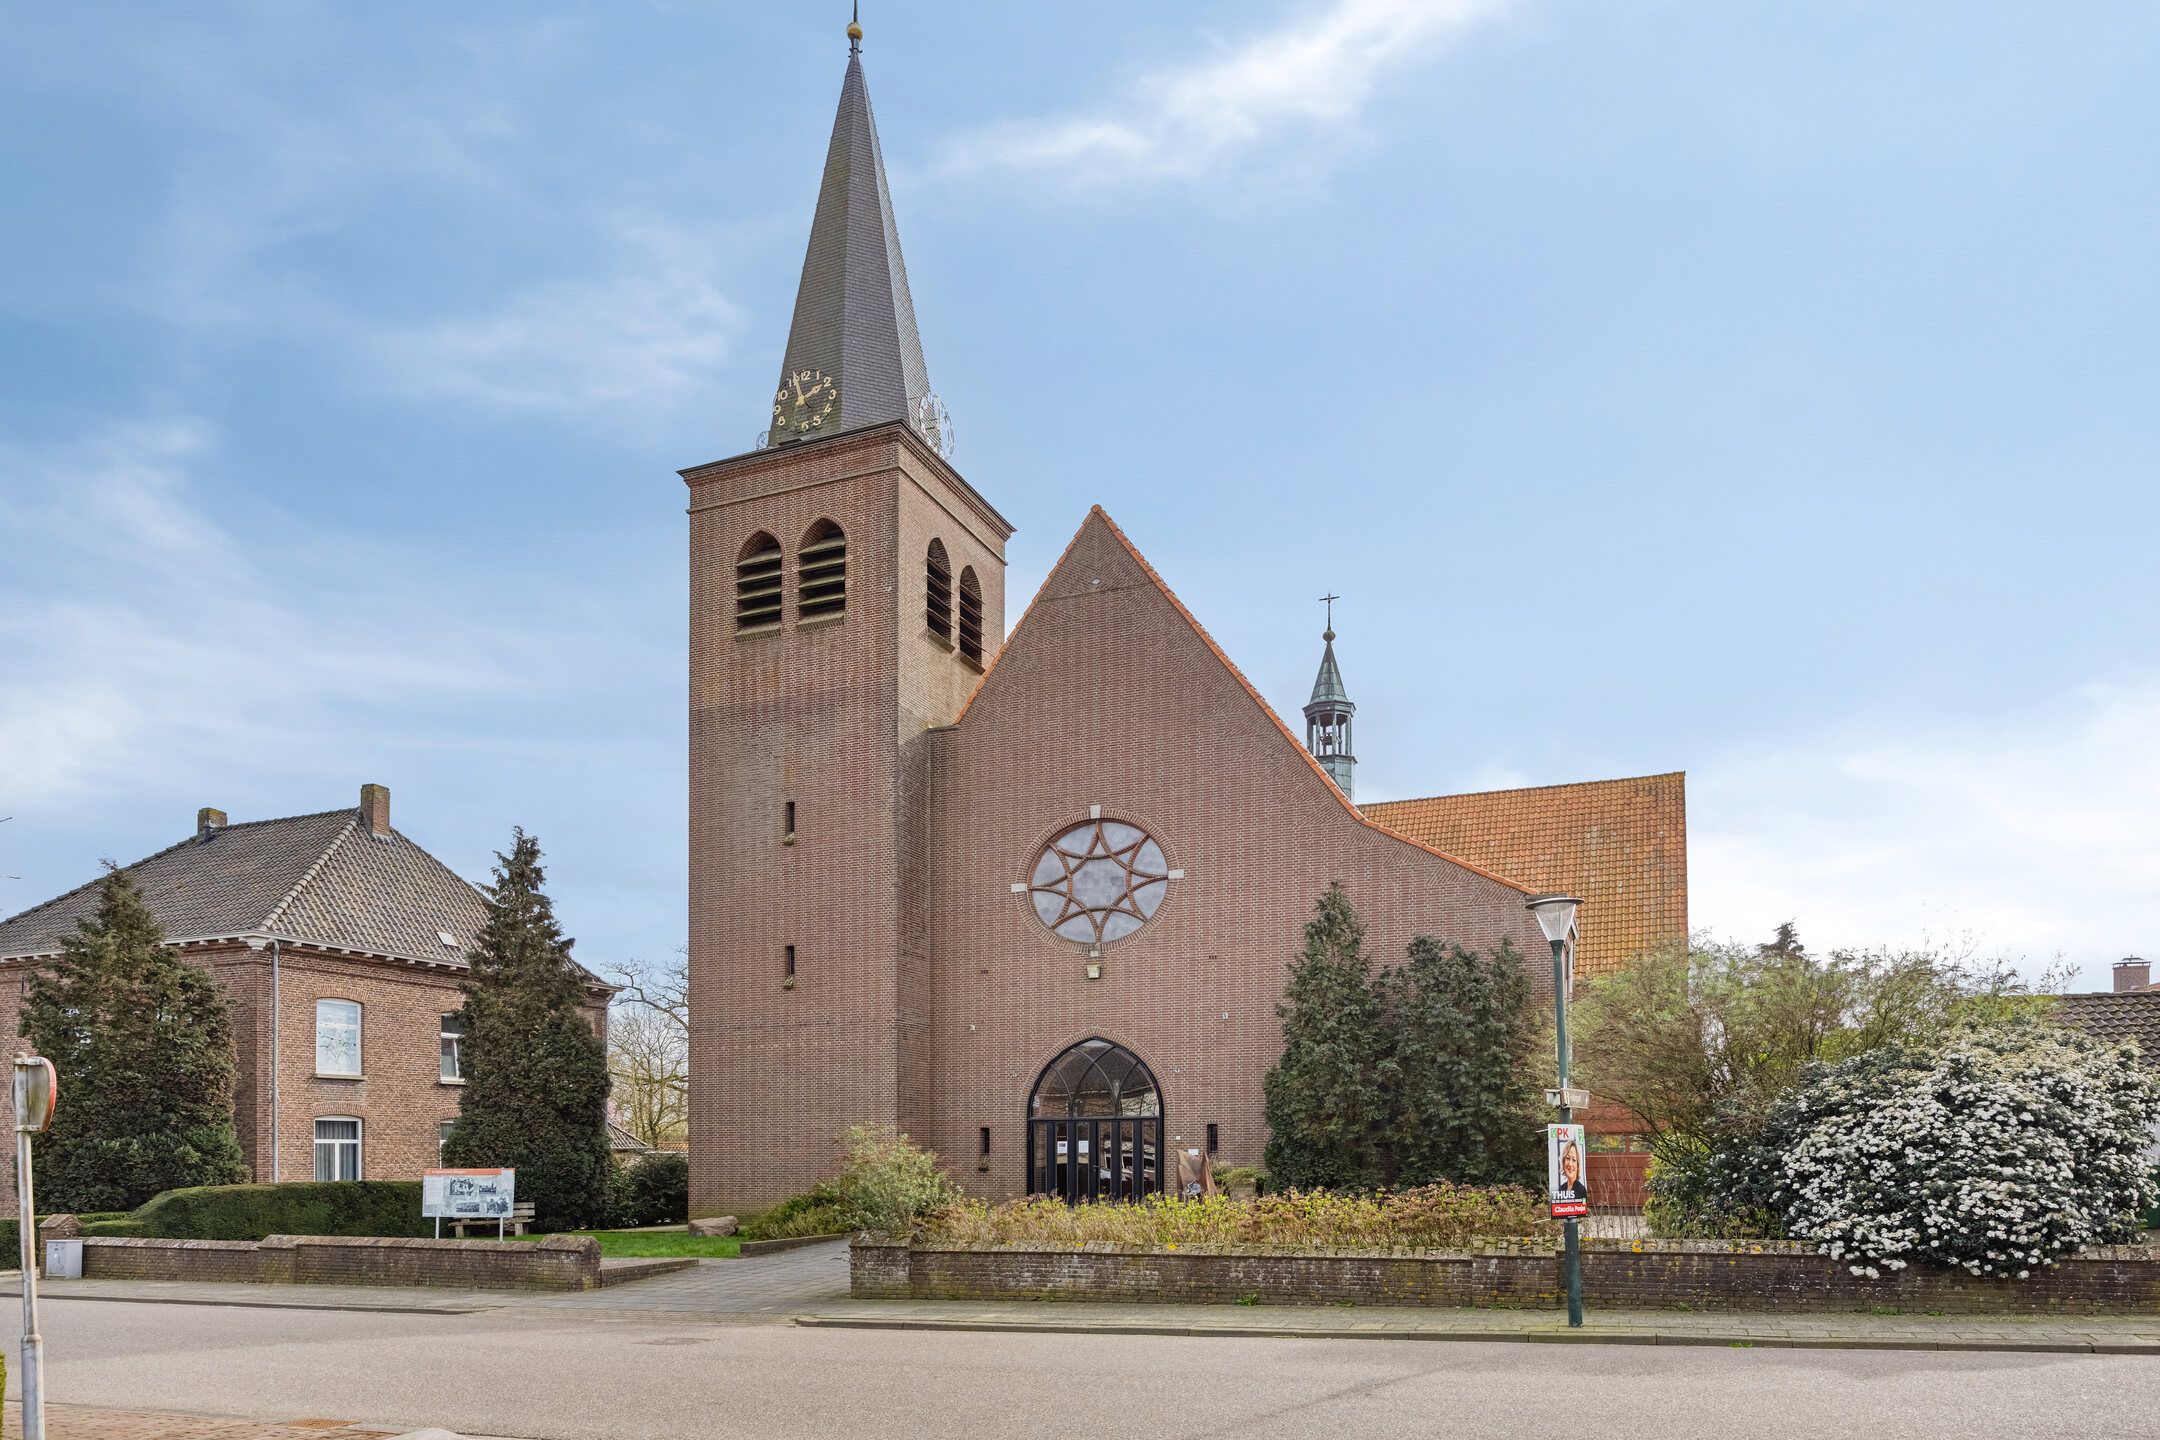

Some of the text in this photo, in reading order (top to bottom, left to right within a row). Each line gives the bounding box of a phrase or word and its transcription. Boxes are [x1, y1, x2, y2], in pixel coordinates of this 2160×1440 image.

[801, 370, 811, 380] 12
[817, 370, 821, 380] 1
[824, 377, 832, 387] 2
[778, 390, 788, 400] 10
[829, 390, 837, 400] 3
[774, 405, 781, 415] 9
[824, 404, 832, 413] 4
[778, 416, 786, 426] 8
[813, 416, 821, 426] 5
[802, 422, 809, 432] 6
[1552, 1190, 1575, 1199] THUIS
